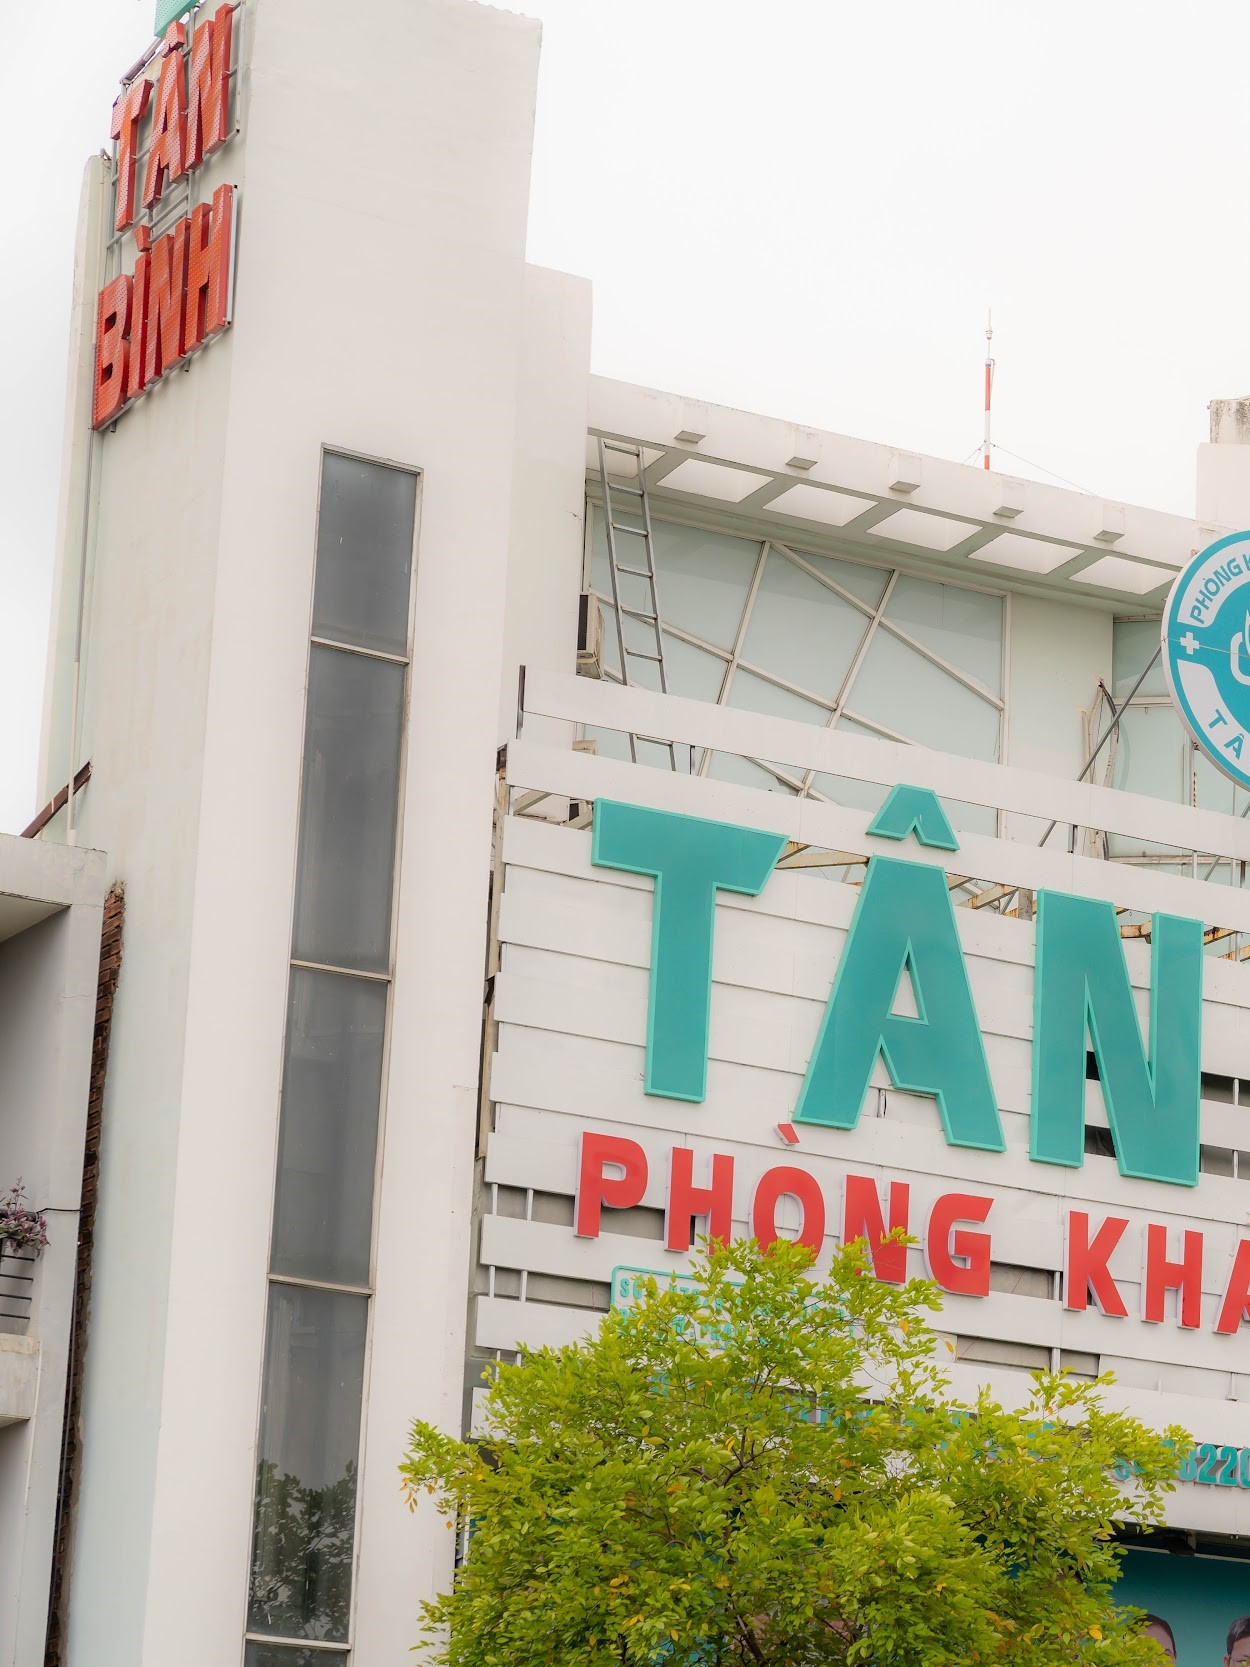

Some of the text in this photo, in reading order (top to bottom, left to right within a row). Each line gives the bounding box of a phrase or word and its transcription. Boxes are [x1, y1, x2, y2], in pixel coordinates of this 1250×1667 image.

[111, 2, 233, 232] TÂN
[93, 183, 234, 430] BÌNH
[1190, 557, 1243, 624] PHÒNG
[591, 783, 1204, 1187] TÂN
[573, 1122, 994, 1298] PHÒNG
